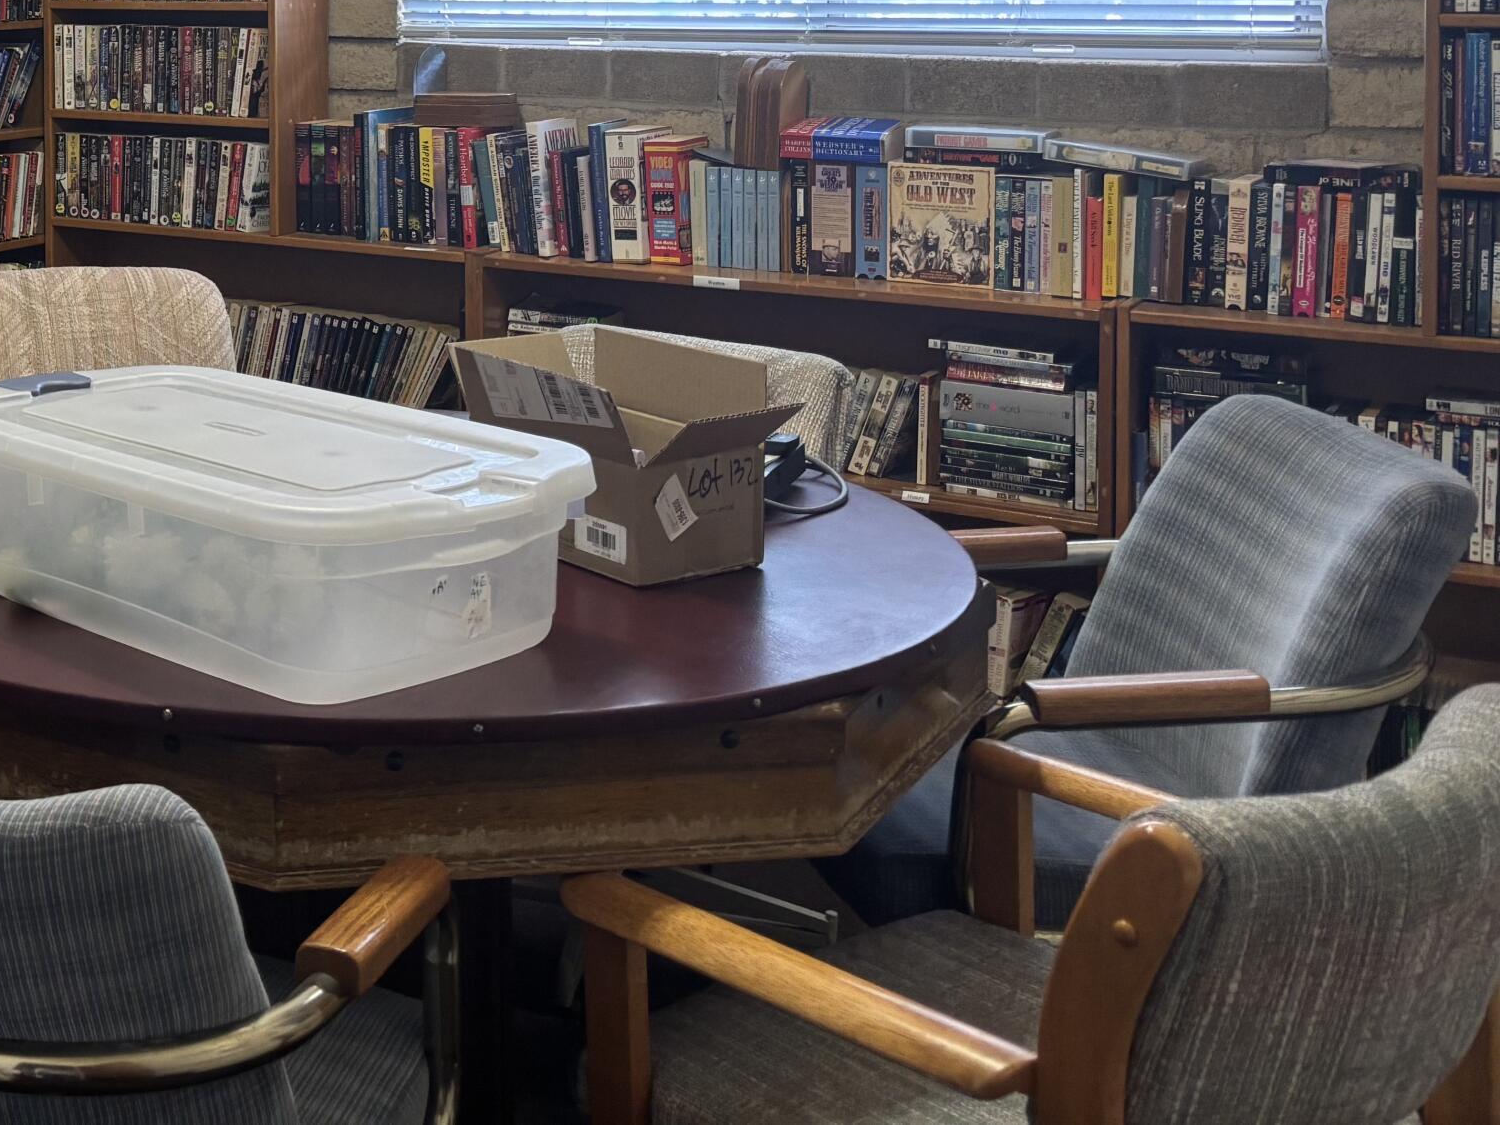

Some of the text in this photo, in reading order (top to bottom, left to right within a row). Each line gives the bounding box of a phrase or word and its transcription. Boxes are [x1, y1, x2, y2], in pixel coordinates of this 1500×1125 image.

[459, 149, 467, 184] Heartbeat
[528, 134, 539, 173] AMERICA
[651, 157, 673, 169] VIDEO
[531, 175, 541, 186] Out
[908, 171, 974, 183] ADVENTURES
[534, 197, 542, 209] the
[907, 186, 975, 205] OLD WEST
[1194, 196, 1205, 261] SLING BLADE
[1230, 207, 1247, 244] RED RIVER
[1255, 192, 1267, 247] SYLVIA BROWNE
[1452, 239, 1460, 259] RED
[688, 456, 723, 498] Lot
